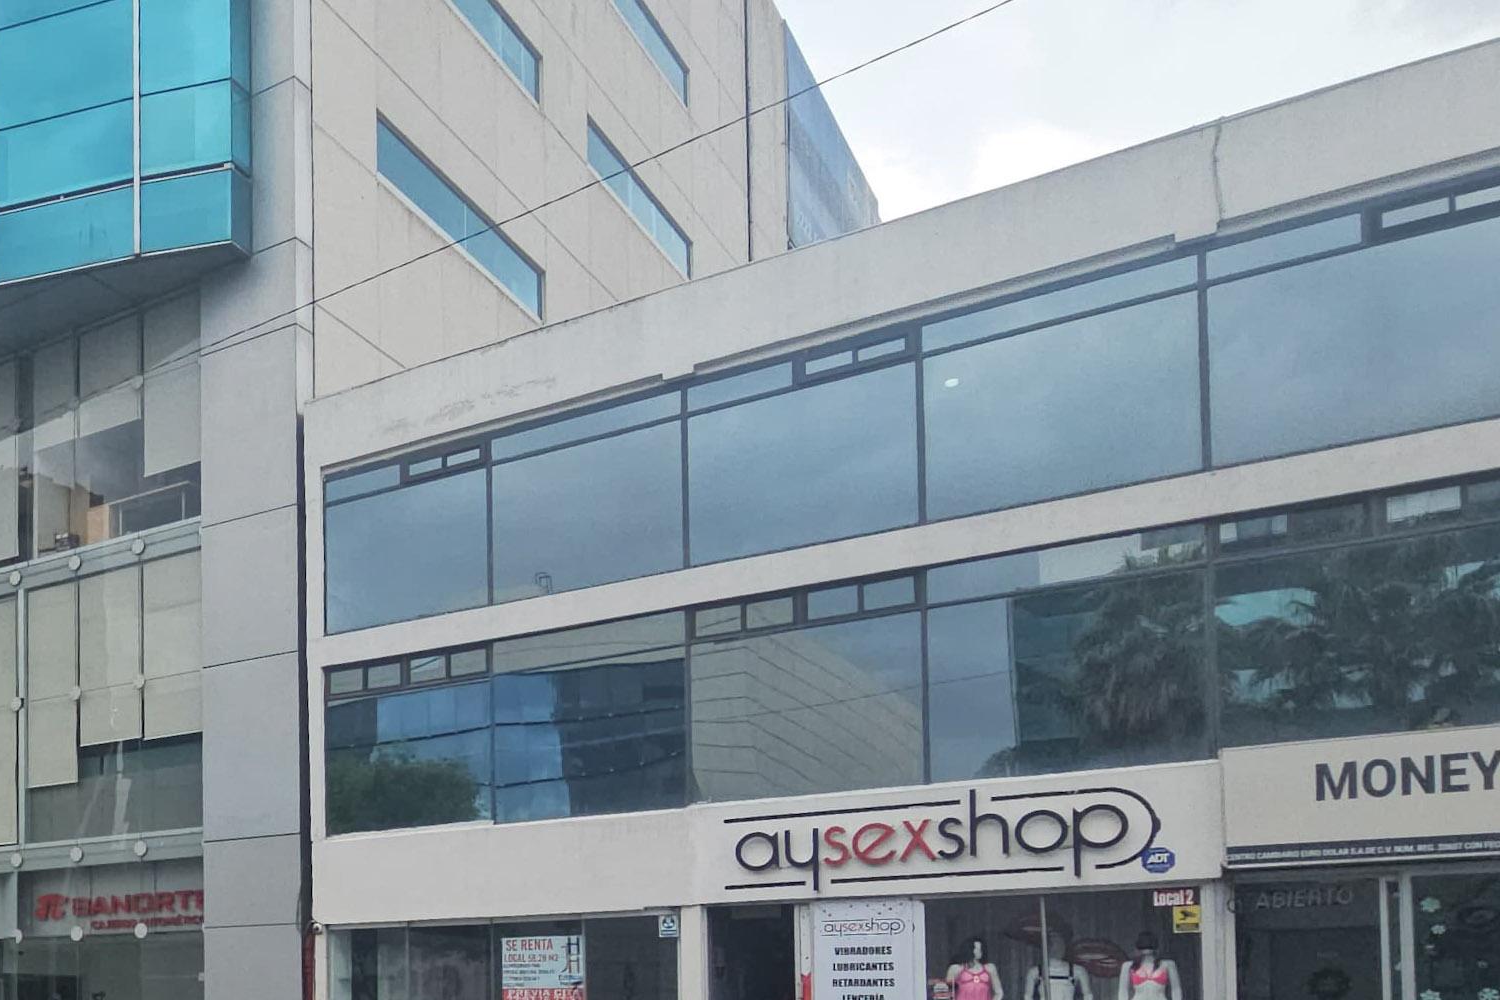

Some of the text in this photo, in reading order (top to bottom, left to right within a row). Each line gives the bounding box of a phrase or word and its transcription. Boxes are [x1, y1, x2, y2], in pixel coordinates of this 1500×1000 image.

[1315, 750, 1500, 801] MONEY
[735, 788, 1130, 892] aysexshop
[1147, 853, 1170, 864] ADT
[1153, 888, 1195, 907] Local 2
[521, 938, 553, 951] RENTA
[834, 946, 892, 955] VIBRADORES
[833, 962, 894, 971] LUBRICANTES
[833, 978, 895, 987] RETARDANTES
